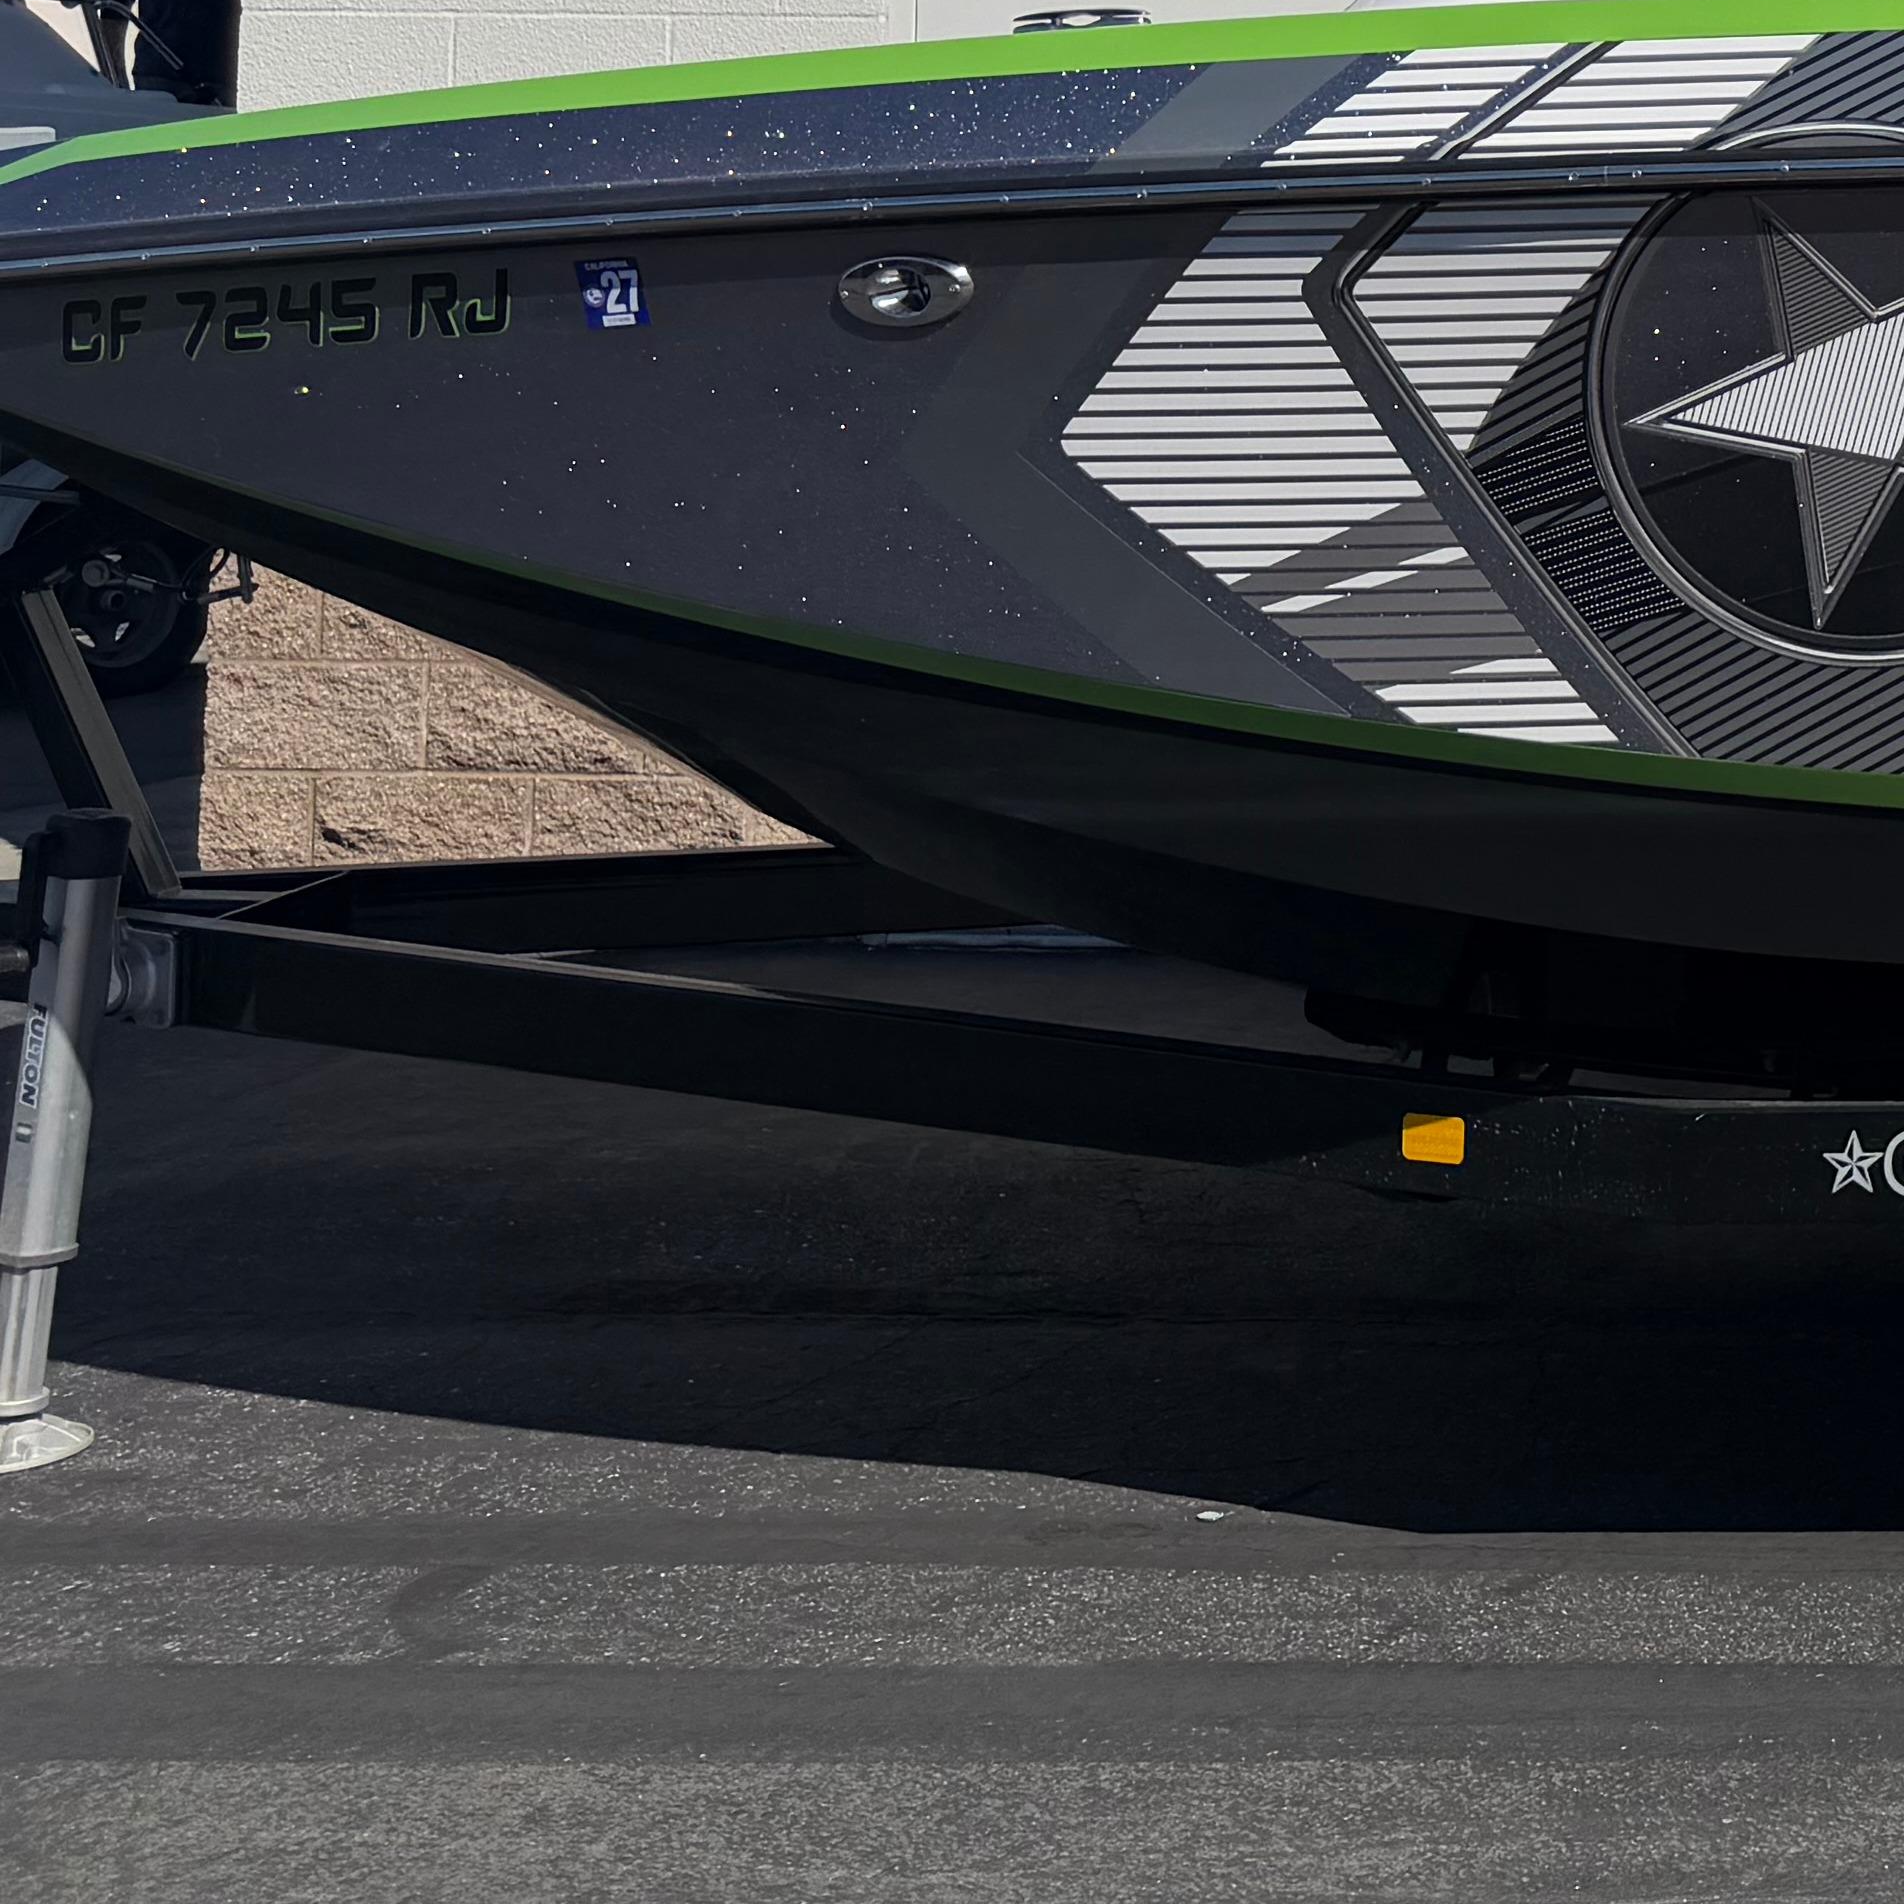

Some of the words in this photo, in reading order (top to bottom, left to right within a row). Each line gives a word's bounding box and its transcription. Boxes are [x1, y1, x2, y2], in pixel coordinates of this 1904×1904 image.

[60, 294, 148, 364] CF
[175, 276, 383, 361] 7245
[408, 267, 513, 340] RJ
[600, 269, 640, 314] 27
[19, 1002, 49, 1110] FULTON
